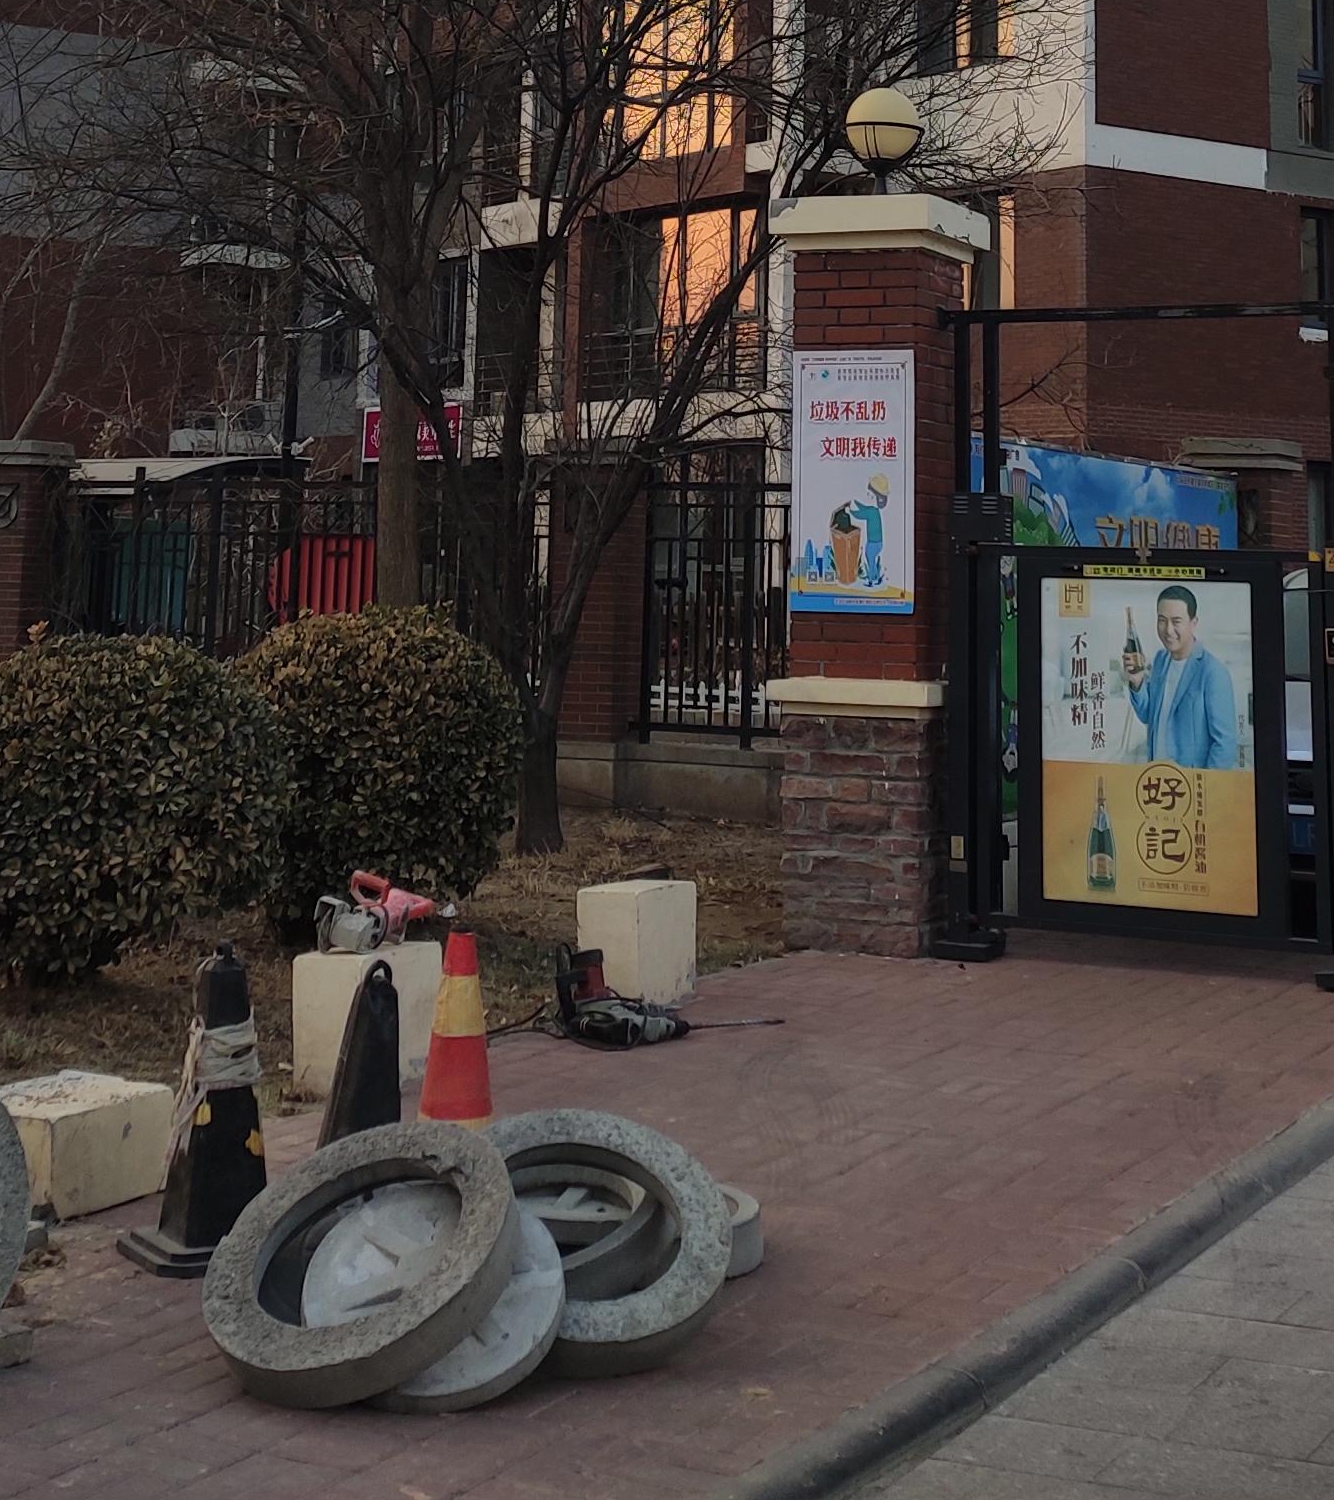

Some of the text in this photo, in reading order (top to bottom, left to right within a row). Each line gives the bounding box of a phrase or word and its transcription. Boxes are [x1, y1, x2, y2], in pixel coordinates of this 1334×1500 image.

[809, 400, 886, 421] 垃圾不乱扔
[820, 437, 897, 458] 文明我传递
[1070, 631, 1089, 726] 不加味精
[1091, 671, 1107, 750] 鲜香自然
